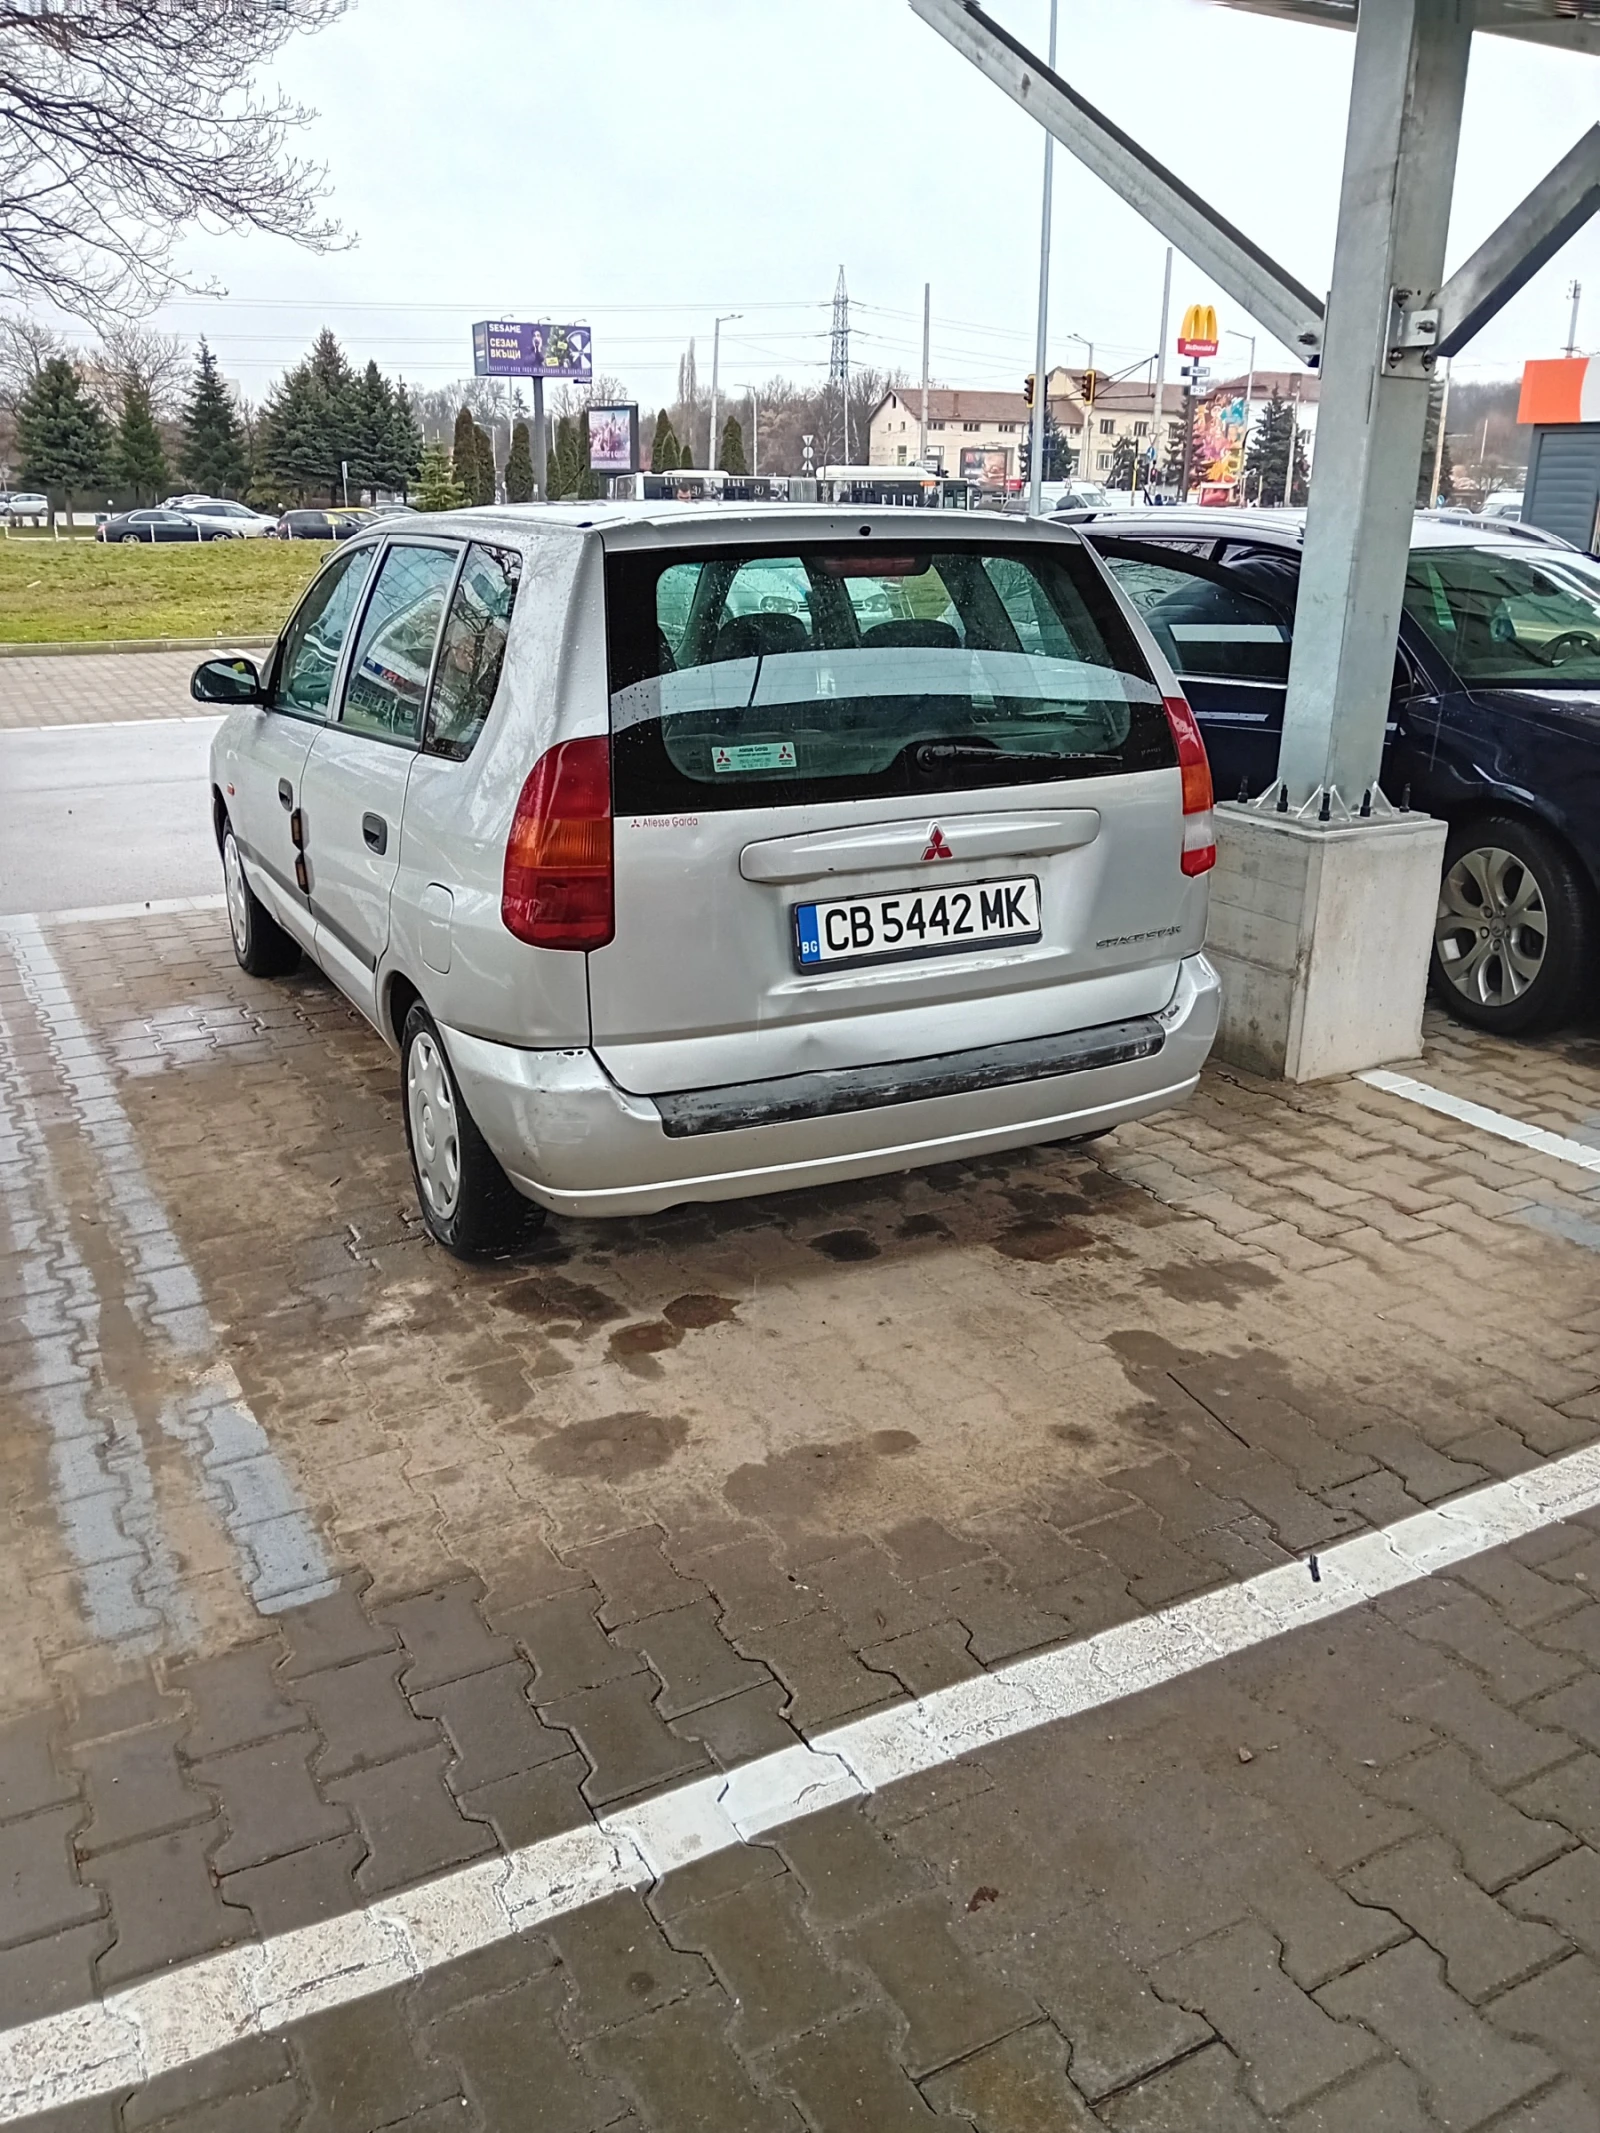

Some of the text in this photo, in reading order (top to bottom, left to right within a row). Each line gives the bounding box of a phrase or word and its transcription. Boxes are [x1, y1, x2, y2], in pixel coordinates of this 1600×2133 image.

[489, 324, 521, 334] SESAME
[490, 338, 518, 349] СЕЗАМ
[490, 349, 521, 360] ВКЪЩИ
[671, 816, 699, 828] Garda
[825, 885, 1031, 951] CB 5442 MK
[801, 940, 818, 955] BG
